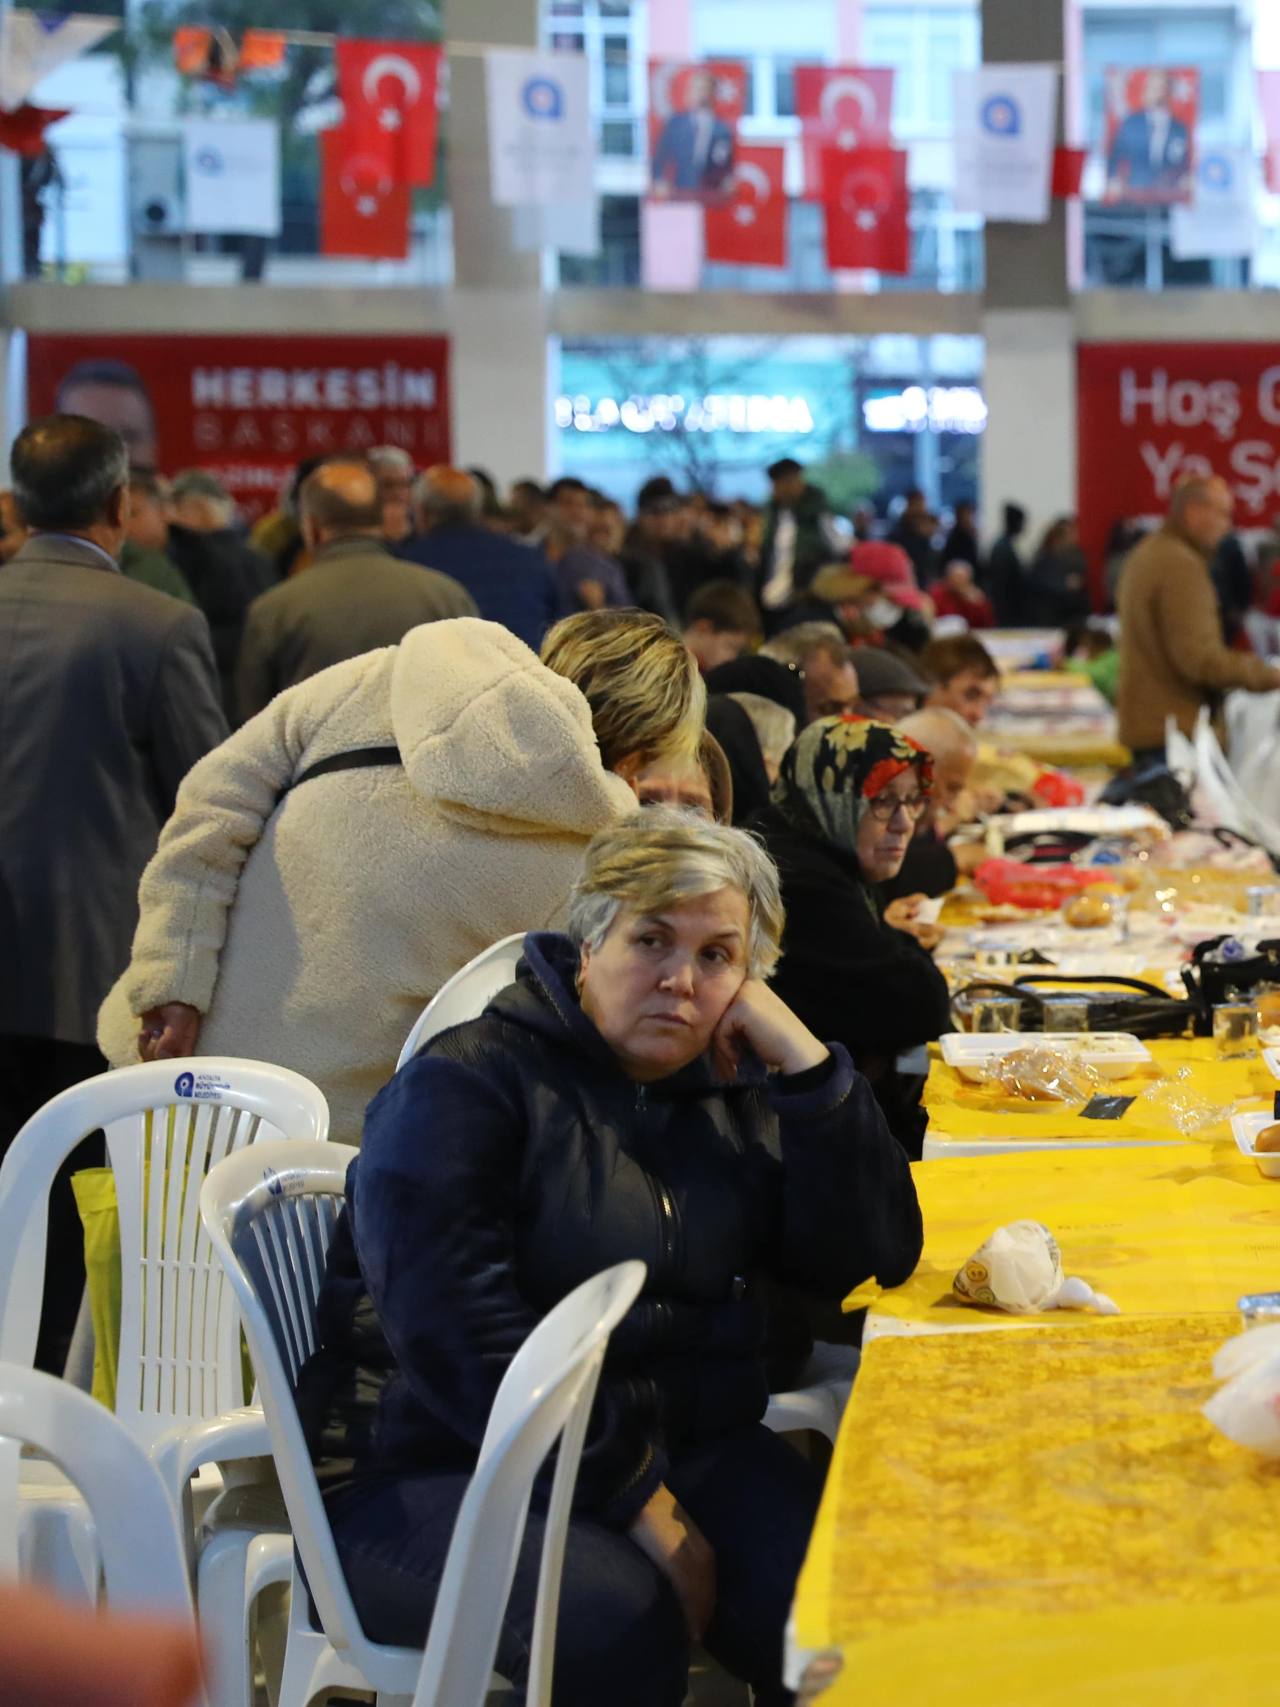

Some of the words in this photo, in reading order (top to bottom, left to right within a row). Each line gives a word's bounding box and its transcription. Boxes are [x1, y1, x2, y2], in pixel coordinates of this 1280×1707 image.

[192, 361, 437, 409] HERKESİN
[1120, 367, 1240, 440] Hoş
[194, 412, 442, 452] BAŞKANI
